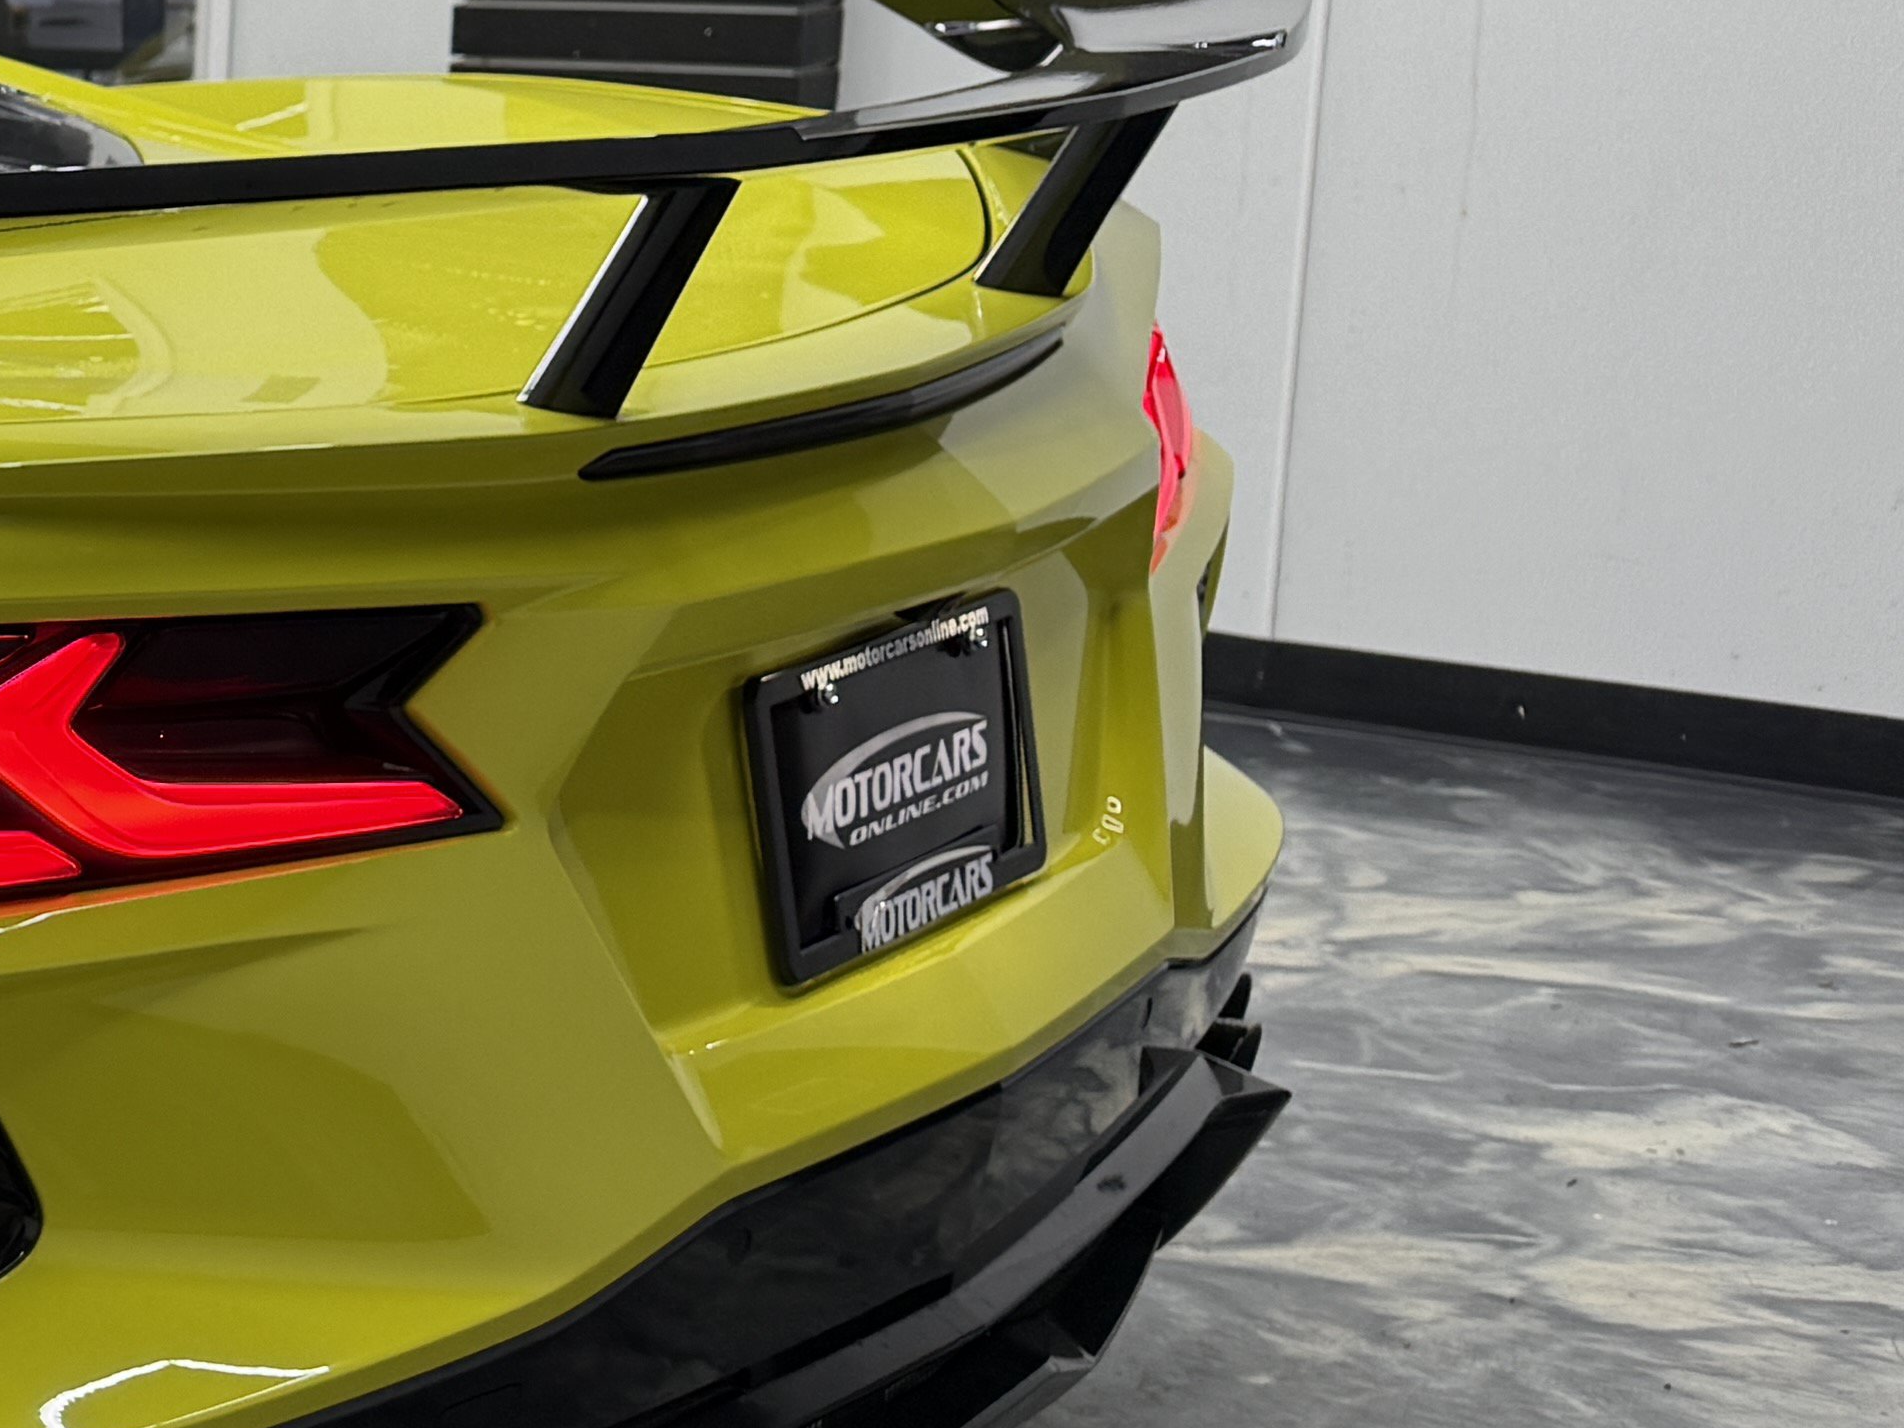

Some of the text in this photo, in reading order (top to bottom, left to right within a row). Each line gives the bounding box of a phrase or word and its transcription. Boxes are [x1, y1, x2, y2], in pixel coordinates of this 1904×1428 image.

[800, 606, 990, 691] www.motorcarsonline.com
[806, 719, 989, 841] MOTORCARS
[849, 770, 990, 847] ONLINE.COM
[860, 851, 993, 955] MOTORCARS
